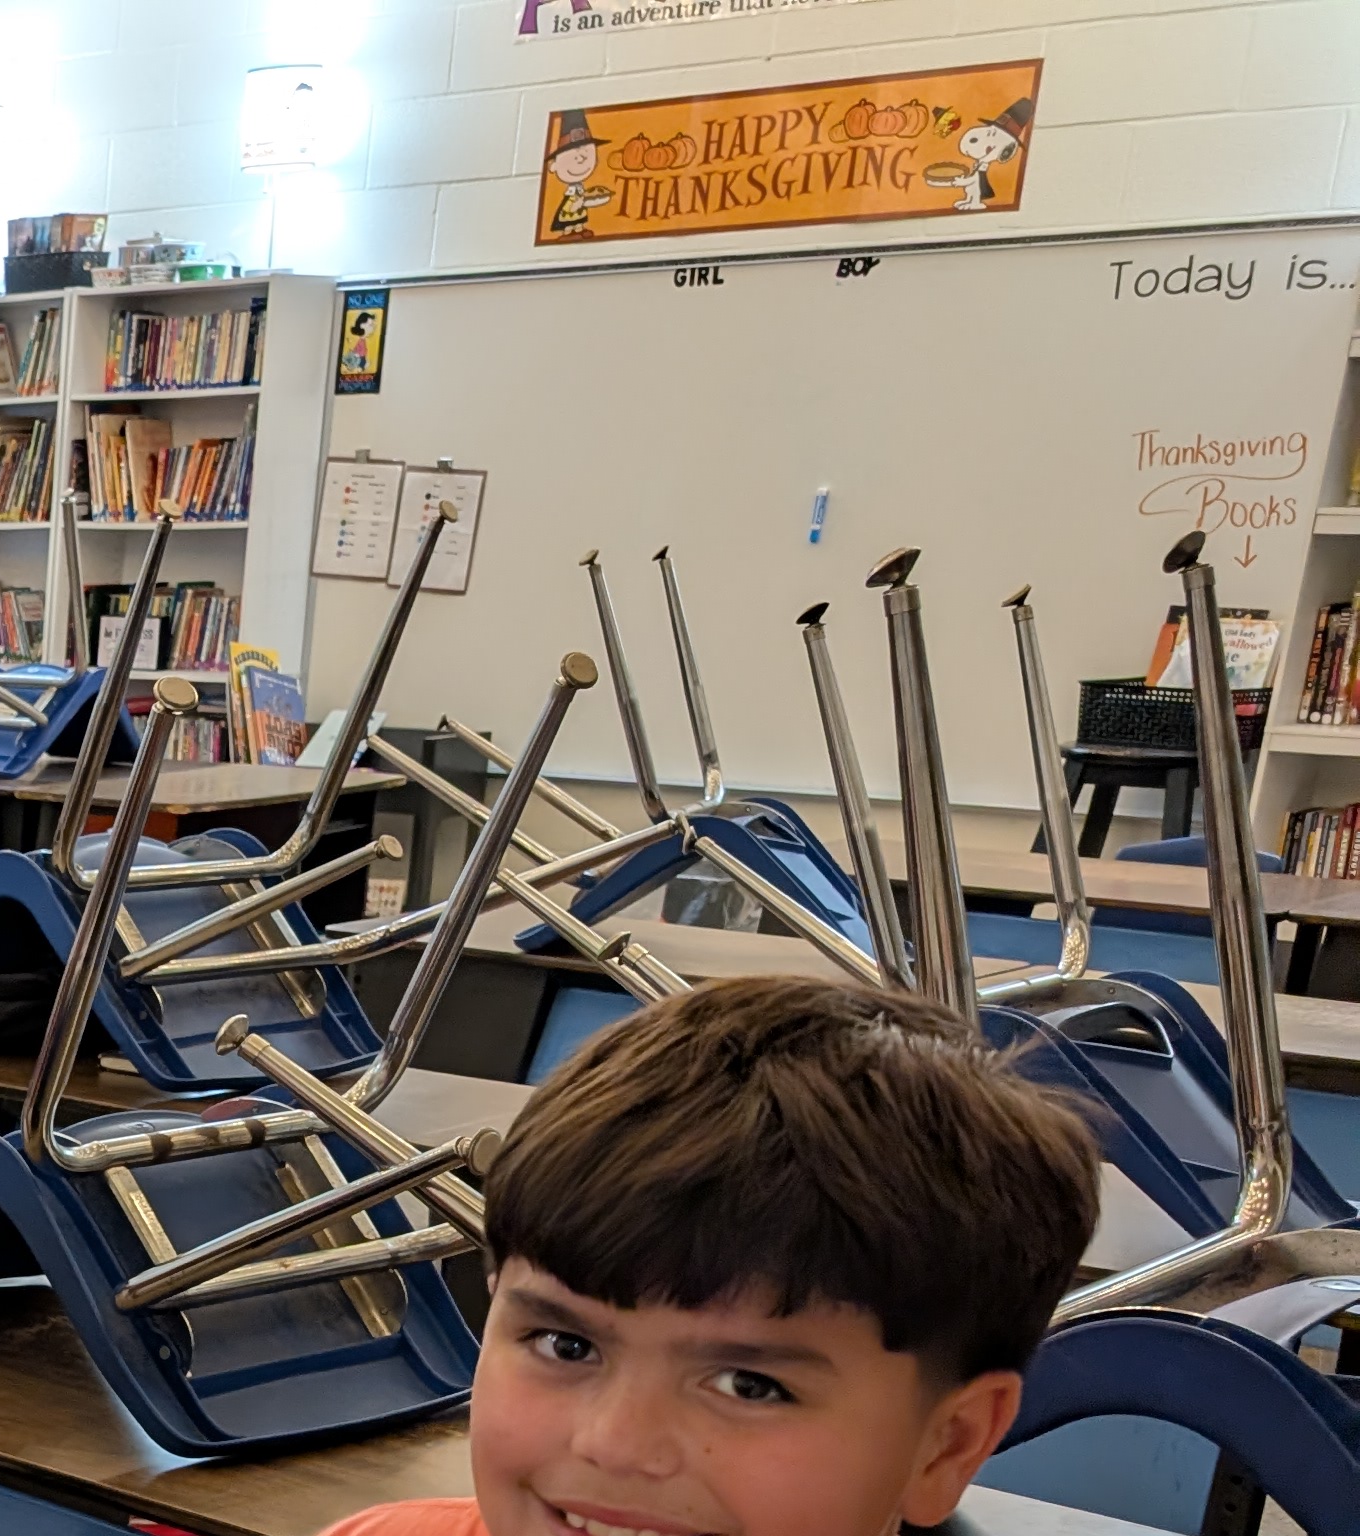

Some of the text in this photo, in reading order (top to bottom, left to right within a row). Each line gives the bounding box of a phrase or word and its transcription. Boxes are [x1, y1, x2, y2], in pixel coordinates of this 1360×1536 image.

[552, 14, 571, 33] is
[577, 13, 605, 31] an
[610, 1, 721, 27] adventure
[698, 101, 833, 167] HAPPY
[613, 145, 920, 221] THANKSGIVING
[673, 266, 725, 288] GIRL
[835, 256, 881, 279] BOY
[1109, 254, 1256, 301] Today
[1132, 429, 1308, 479] Thanksgiving
[1185, 477, 1297, 535] Books
[1225, 636, 1273, 651] allowed
